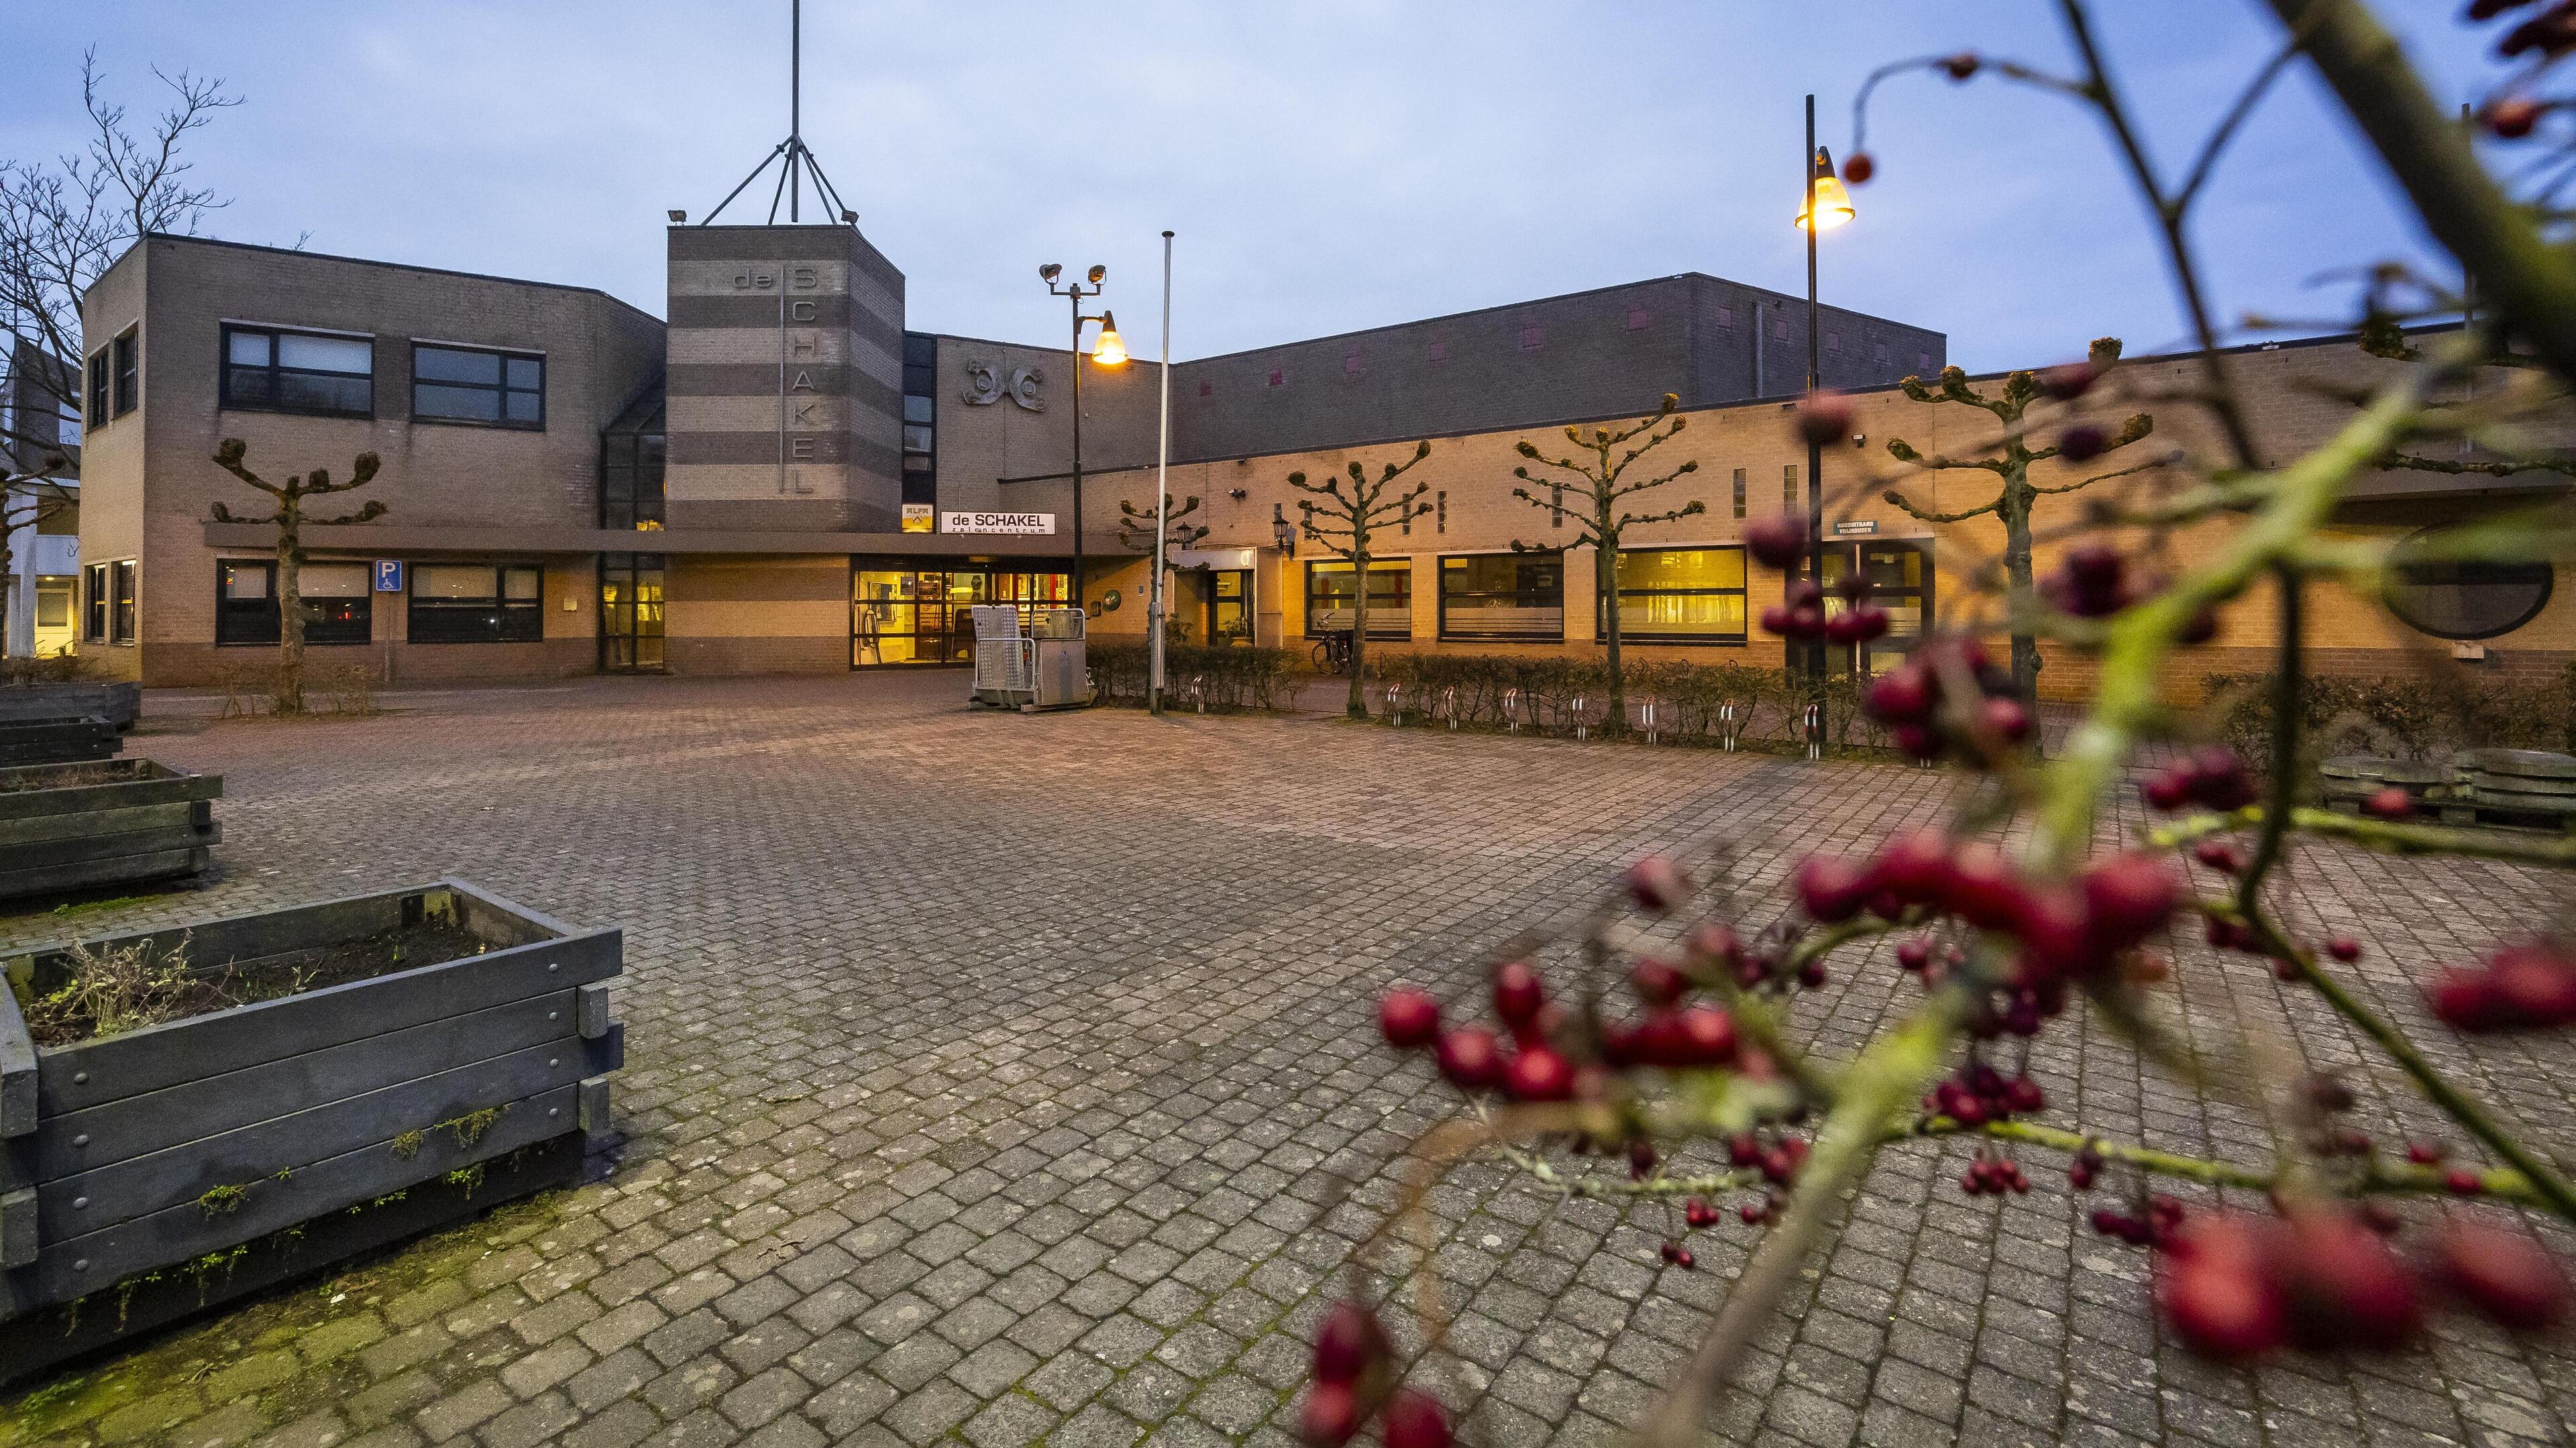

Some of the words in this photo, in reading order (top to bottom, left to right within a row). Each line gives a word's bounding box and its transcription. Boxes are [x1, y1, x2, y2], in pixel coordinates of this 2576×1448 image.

[734, 268, 773, 289] de
[792, 268, 817, 495] SCHAKEL
[952, 514, 969, 526] de
[975, 514, 1044, 526] SCHAKEL
[382, 563, 396, 577] P
